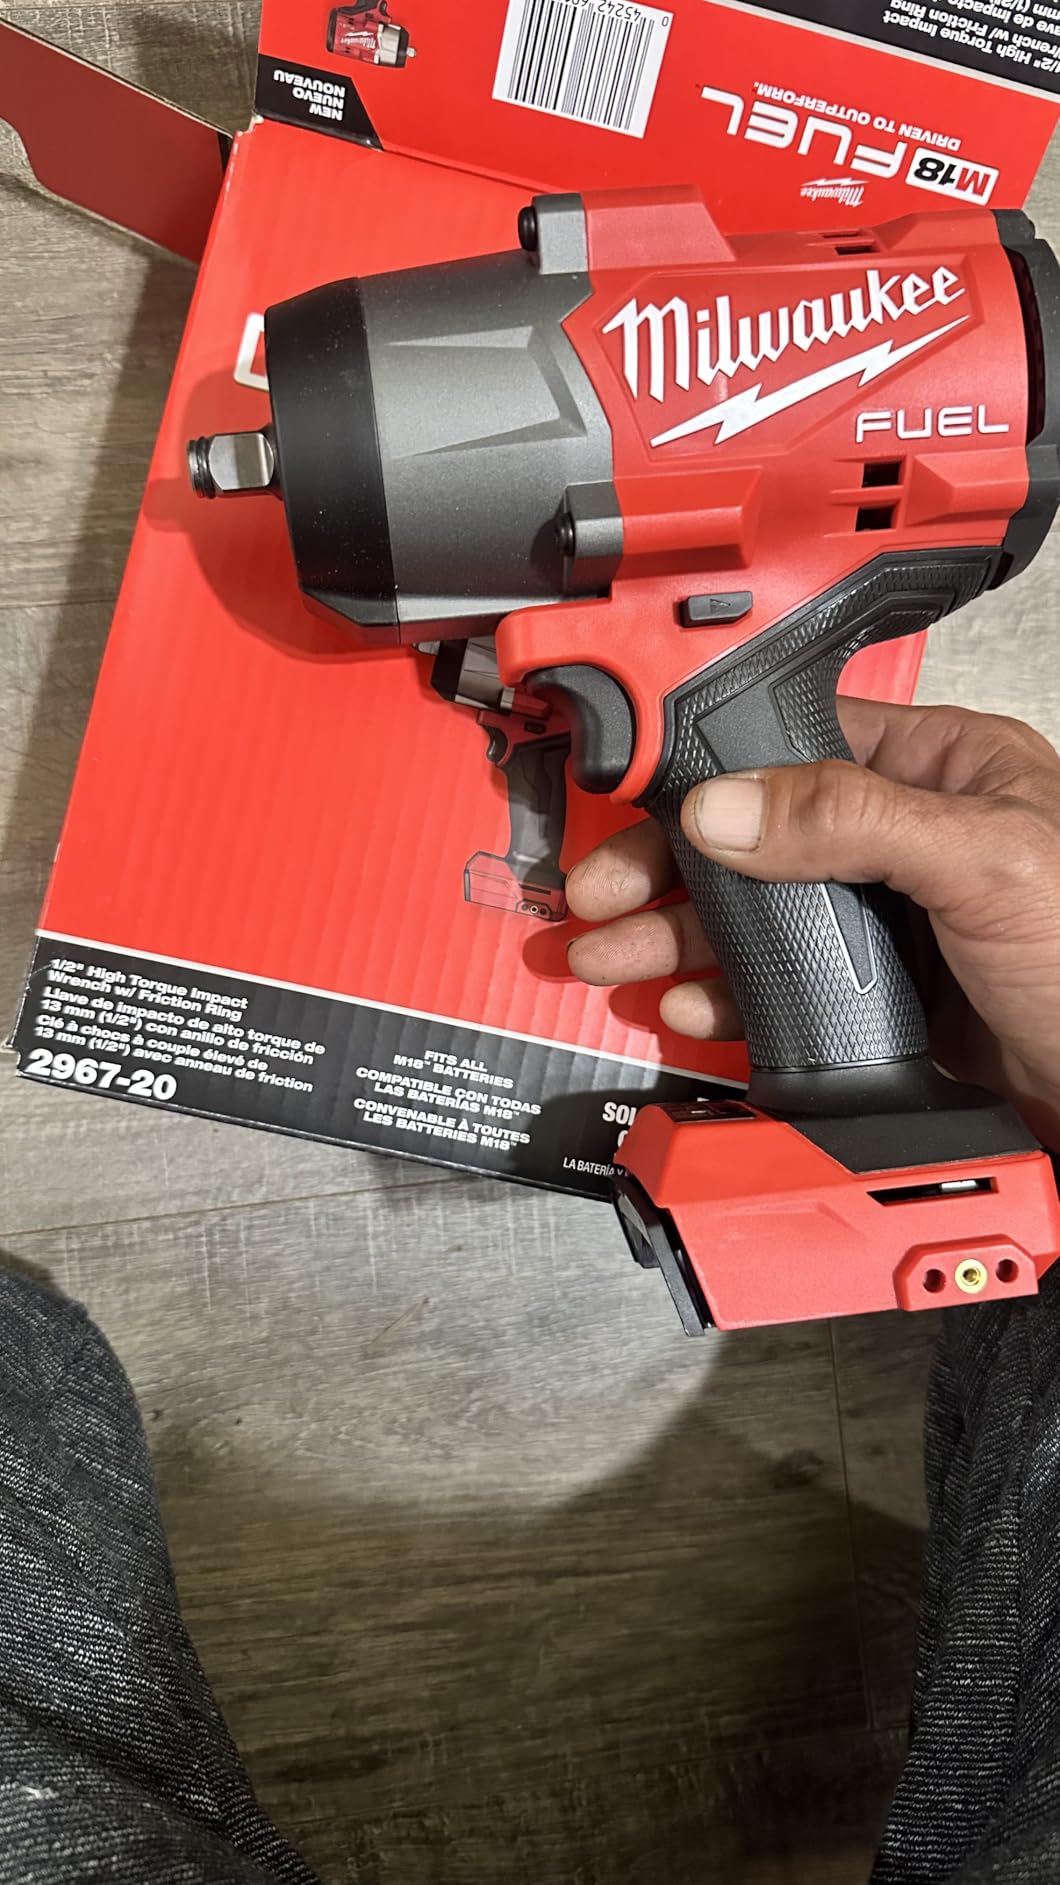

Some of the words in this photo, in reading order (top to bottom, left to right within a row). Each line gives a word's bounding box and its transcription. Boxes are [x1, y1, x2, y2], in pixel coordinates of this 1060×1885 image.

[598, 0, 641, 21] 45242
[661, 16, 669, 27] 0
[883, 10, 938, 37] Impact
[890, 0, 927, 19] Ring
[929, 9, 988, 37] Friction
[1013, 13, 1034, 28] de
[940, 27, 992, 53] Torque
[988, 27, 1009, 41] w/
[1036, 20, 1060, 36] ave
[996, 44, 1032, 64] High
[273, 70, 345, 98] NOUVEAU
[292, 87, 344, 109] NUEVO
[310, 103, 343, 121] NEW
[754, 82, 870, 125] OUTPERFORM.
[701, 86, 907, 178] FUEL
[873, 116, 896, 133] TO
[898, 123, 961, 151] DRIVEN
[914, 157, 991, 197] M18
[800, 184, 864, 208] Milwaukee
[603, 265, 965, 402] Milwaukee
[855, 404, 1009, 443] FUEL
[48, 970, 111, 993] Wrench
[114, 985, 136, 998] w/
[138, 989, 202, 1011] Friction
[205, 1003, 242, 1022] Ring
[51, 959, 85, 973] 1/2"
[86, 966, 126, 983] High
[129, 974, 188, 996] Torque
[190, 987, 248, 1009] Impact
[41, 999, 62, 1012] 13
[62, 1005, 96, 1019] mm
[98, 1011, 143, 1031] (1/2")
[145, 1022, 177, 1036] con
[180, 1030, 225, 1046] anillo
[227, 1038, 249, 1051] de
[252, 1042, 314, 1065] fricción
[43, 986, 89, 1005] Llave
[90, 997, 114, 1010] de
[116, 1002, 185, 1025] impacto
[187, 1017, 210, 1030] de
[212, 1023, 244, 1037] alto
[248, 1029, 301, 1049] torque
[304, 1041, 325, 1055] de
[36, 1014, 65, 1029] Clé
[65, 1020, 79, 1032] à
[80, 1025, 131, 1043] chocs
[131, 1034, 145, 1046] à
[145, 1039, 200, 1057] couple
[202, 1049, 245, 1066] élevé
[247, 1058, 268, 1071] de
[34, 1026, 54, 1039] 13
[55, 1031, 87, 1046] mm
[88, 1037, 131, 1057] (1/2")
[132, 1048, 173, 1063] avec
[174, 1056, 233, 1076] anneau
[234, 1068, 255, 1081] de
[257, 1071, 314, 1092] friction
[424, 1050, 457, 1066] FITS
[460, 1058, 488, 1072] ALL
[24, 1048, 177, 1100] 2967-20
[433, 1064, 514, 1089] BATTERIES
[355, 1067, 453, 1096] COMPATIBLE
[455, 1087, 488, 1104] CON
[491, 1095, 542, 1115] TODAS
[374, 1082, 405, 1097] LAS
[407, 1091, 480, 1113] BATERÍAS
[353, 1098, 456, 1128] CONVENABLE
[458, 1118, 470, 1131] À
[472, 1123, 531, 1144] TOUTES
[363, 1111, 393, 1126] LES
[396, 1118, 478, 1144] BATTERIES
[563, 1156, 576, 1170] LA
[577, 1159, 615, 1176] BATERÍA
